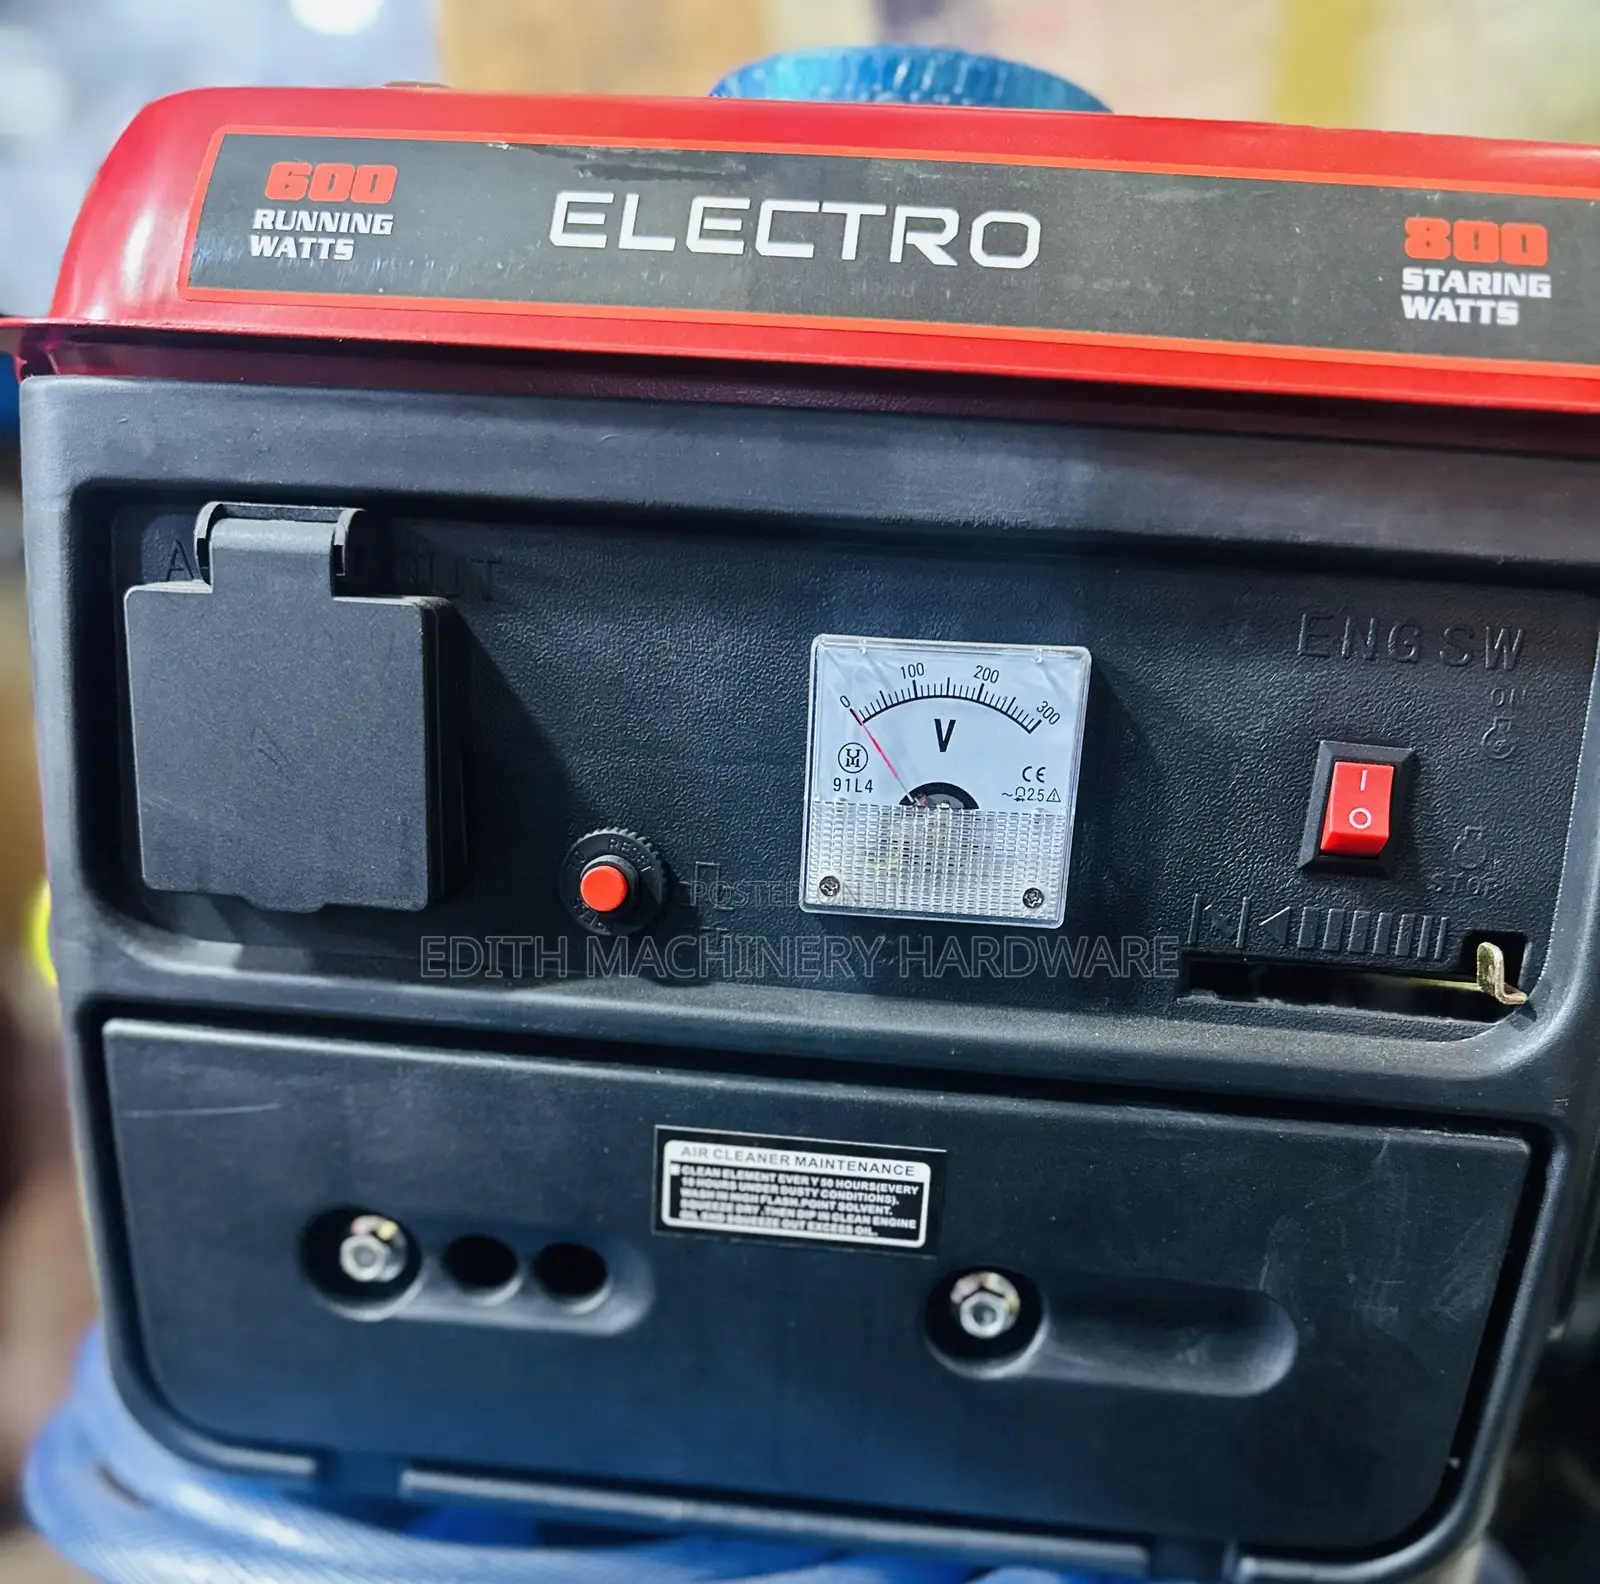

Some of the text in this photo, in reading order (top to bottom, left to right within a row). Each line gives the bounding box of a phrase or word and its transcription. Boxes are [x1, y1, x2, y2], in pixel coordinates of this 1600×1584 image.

[264, 161, 398, 204] 600
[252, 208, 394, 236] RUNNING
[549, 191, 1042, 269] ELECTRO
[249, 234, 355, 261] WATTS
[1404, 216, 1549, 267] 800
[1402, 266, 1552, 299] STARING
[1400, 295, 1520, 326] WATTS
[1297, 613, 1527, 672] ENG SW
[900, 662, 925, 680] 100
[973, 664, 1000, 684] 200
[839, 695, 851, 708] 0
[1036, 700, 1061, 725] 300
[934, 718, 957, 753] V
[833, 777, 874, 793] 91L4
[681, 1146, 916, 1177] AIR CLEANER MAINTENANCE
